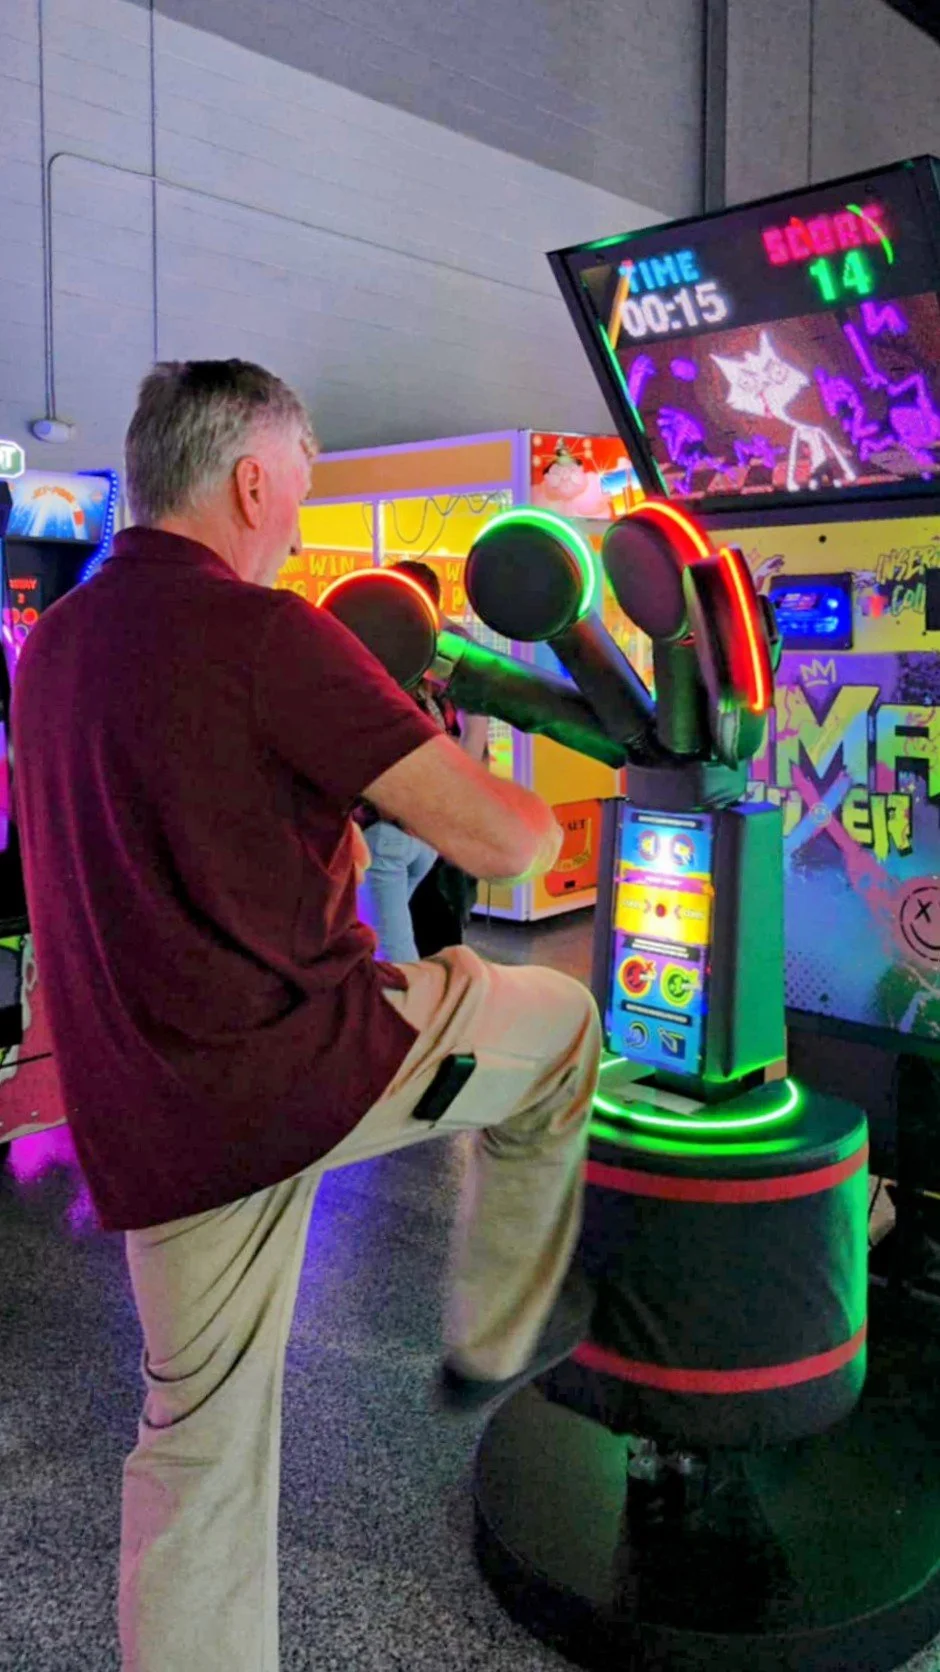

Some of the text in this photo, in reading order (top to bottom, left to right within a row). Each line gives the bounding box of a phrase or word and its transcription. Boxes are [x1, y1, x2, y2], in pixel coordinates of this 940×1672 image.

[763, 204, 884, 266] SCORE
[619, 250, 700, 293] TIME
[809, 250, 871, 301] 14
[620, 282, 727, 338] 00:15
[309, 554, 356, 578] WIN
